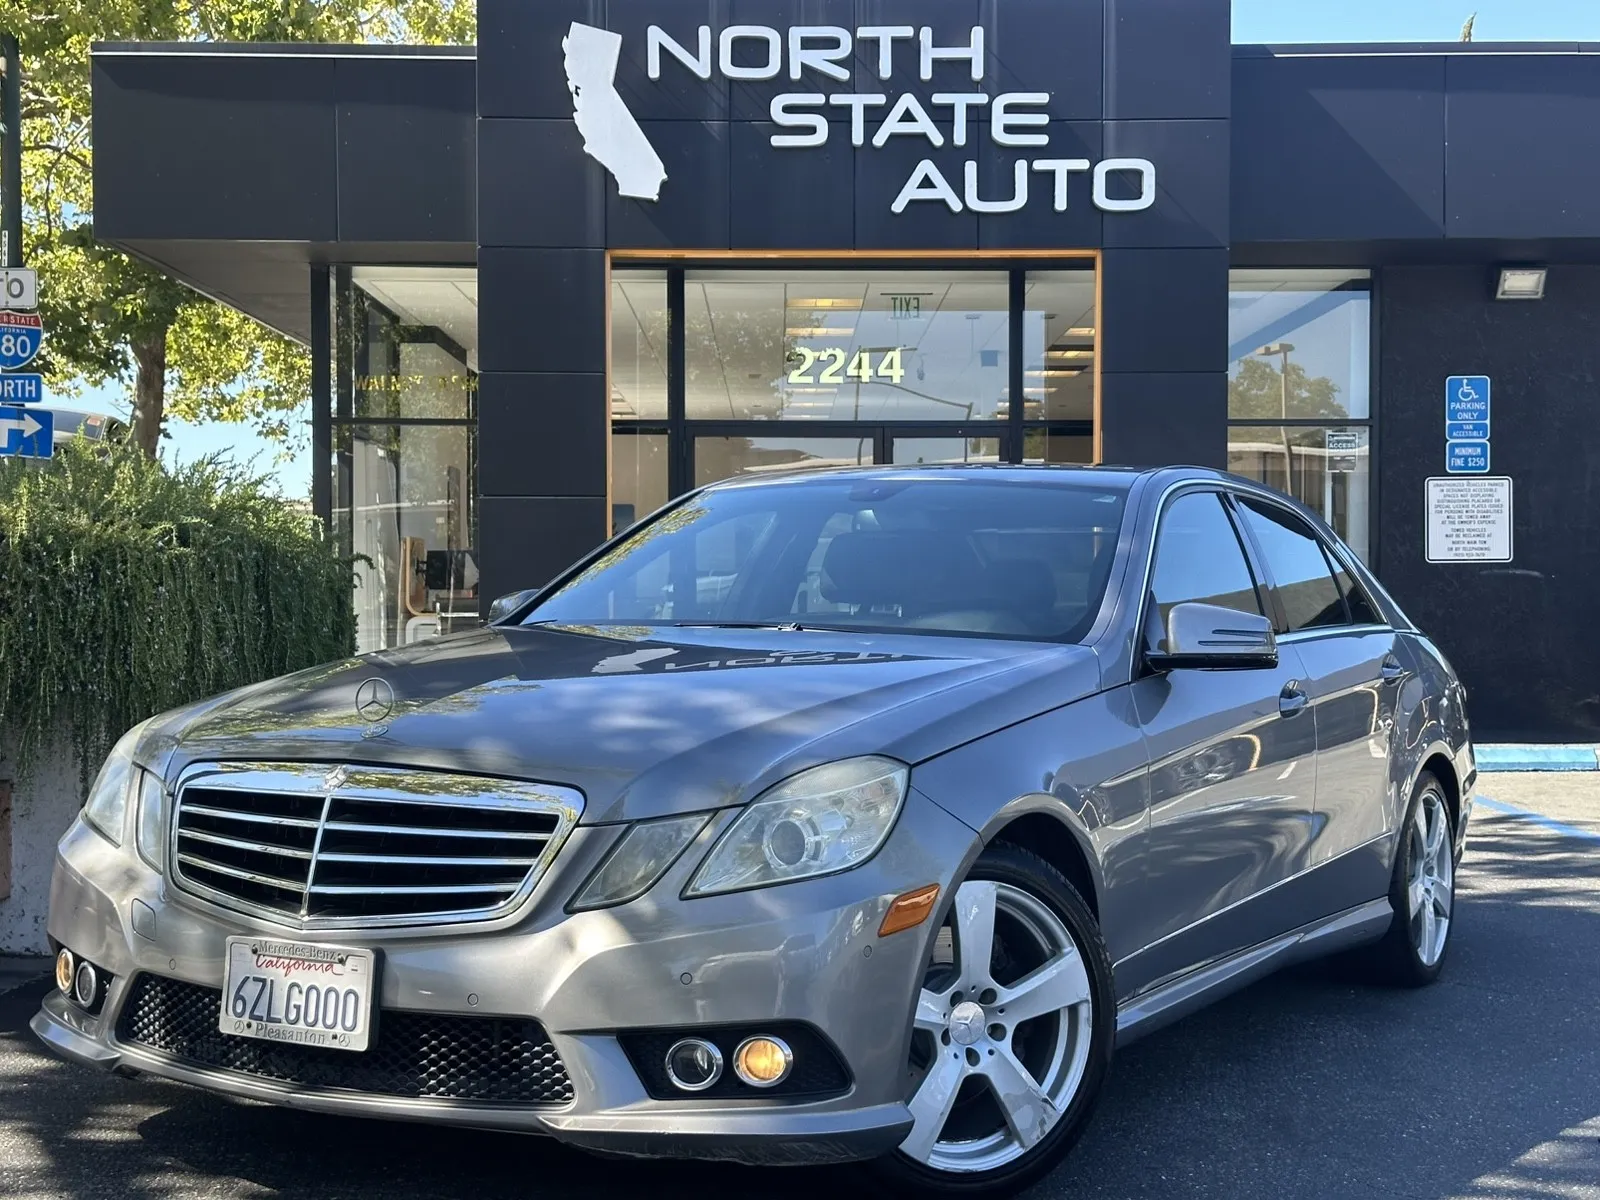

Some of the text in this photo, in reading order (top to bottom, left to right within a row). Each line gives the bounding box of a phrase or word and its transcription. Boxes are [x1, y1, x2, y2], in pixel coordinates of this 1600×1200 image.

[646, 24, 984, 81] NORTH
[769, 92, 1050, 148] STATE
[890, 158, 1156, 214] AUTO
[0, 278, 25, 298] O
[0, 315, 36, 326] RSTATE
[786, 346, 905, 385] 2244
[1450, 402, 1486, 410] PARKING
[1457, 412, 1479, 420] ONLY
[1454, 447, 1482, 455] MINIMUM
[1451, 457, 1485, 467] FINE $250
[258, 940, 337, 960] Mercedes-Benz
[255, 954, 344, 977] California
[231, 975, 360, 1032] 6ZLG000
[255, 1022, 326, 1044] Pleasanton
